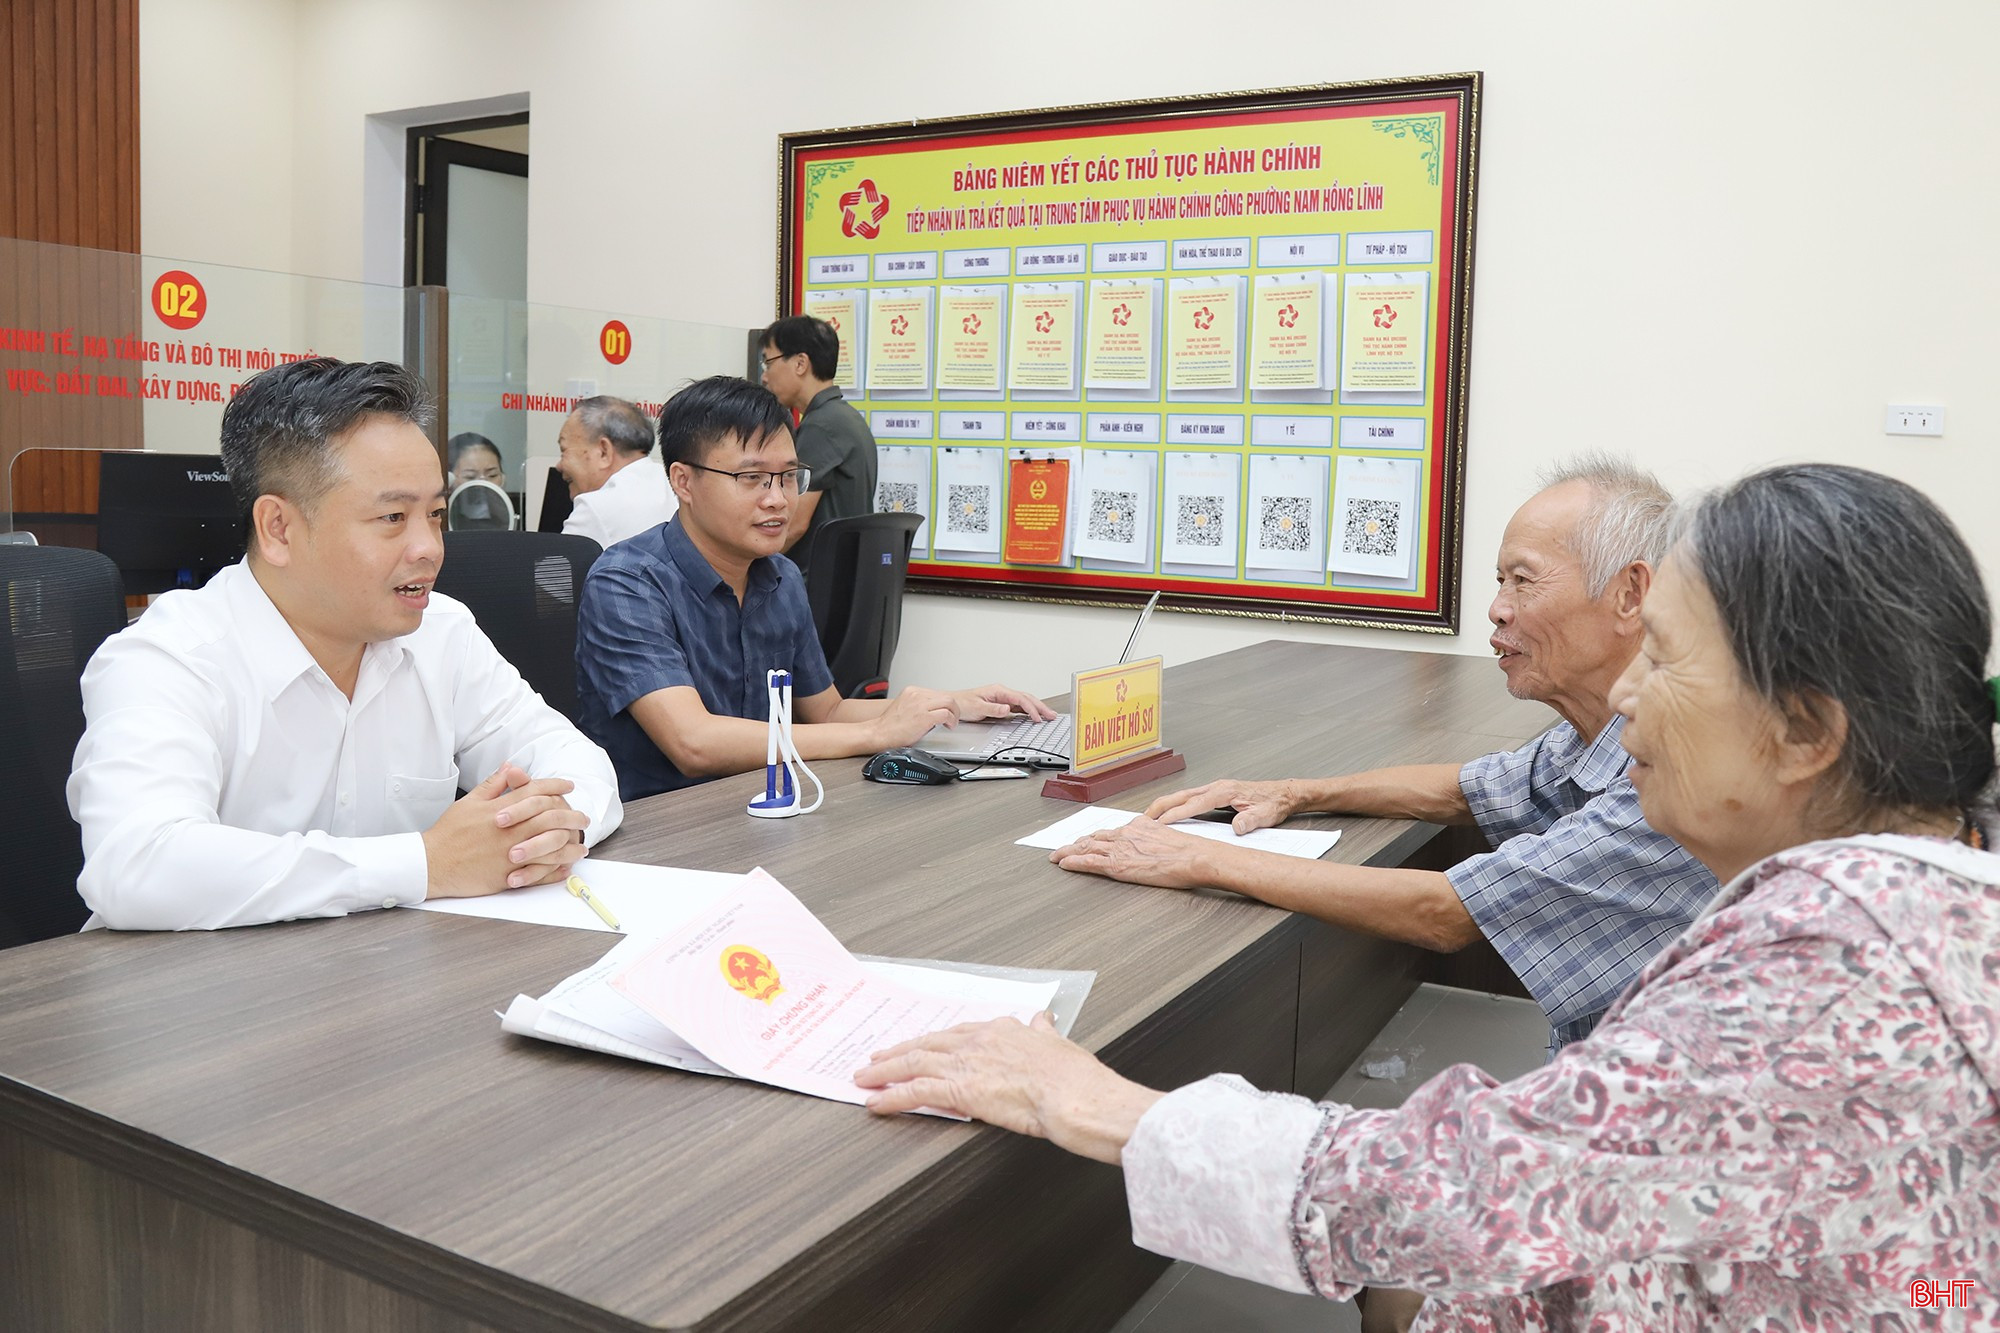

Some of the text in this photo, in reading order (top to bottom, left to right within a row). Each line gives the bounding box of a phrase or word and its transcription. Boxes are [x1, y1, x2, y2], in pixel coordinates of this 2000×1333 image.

[954, 142, 1321, 192] BẢNG NIÊM YẾT CÁC THỦ TỤC HÀNH CHÍNH
[907, 206, 925, 233] TIẾP
[927, 206, 951, 236] NHẬN
[955, 205, 966, 230] VÀ
[969, 201, 985, 229] TRẢ
[988, 200, 1004, 228] KẾT
[1007, 198, 1025, 230] QUẢ
[1029, 204, 1042, 231] TẠI
[1046, 202, 1077, 225] TRUNG
[1080, 197, 1100, 223] TÂM
[1103, 199, 1129, 227] PHỤC
[1133, 198, 1145, 226] VỤ
[1148, 192, 1176, 220] HÀNH
[1179, 191, 1211, 219] CHÍNH
[1214, 189, 1243, 217] CÔNG
[1246, 186, 1290, 215] PHƯỜNG
[1294, 189, 1319, 213] NAM
[1357, 182, 1383, 210] LĨNH
[160, 282, 198, 318] 02
[0, 328, 45, 352] KINH
[50, 328, 78, 358] TẾ,
[83, 335, 109, 362] HẠ
[165, 340, 187, 364] VÀ
[191, 342, 213, 366] ĐÔ
[218, 348, 242, 372] THỊ
[246, 348, 275, 370] MÔI
[605, 329, 626, 356] 01
[6, 368, 51, 397] VỰC:
[56, 365, 92, 396] ĐẤT
[97, 375, 133, 399] ĐAI,
[139, 374, 171, 399] XÂY
[176, 380, 225, 405] DỰNG,
[502, 393, 522, 410] CHI
[526, 393, 567, 413] NHÁNH
[1084, 702, 1154, 751] BÀN VIẾT HỒ SƠ
